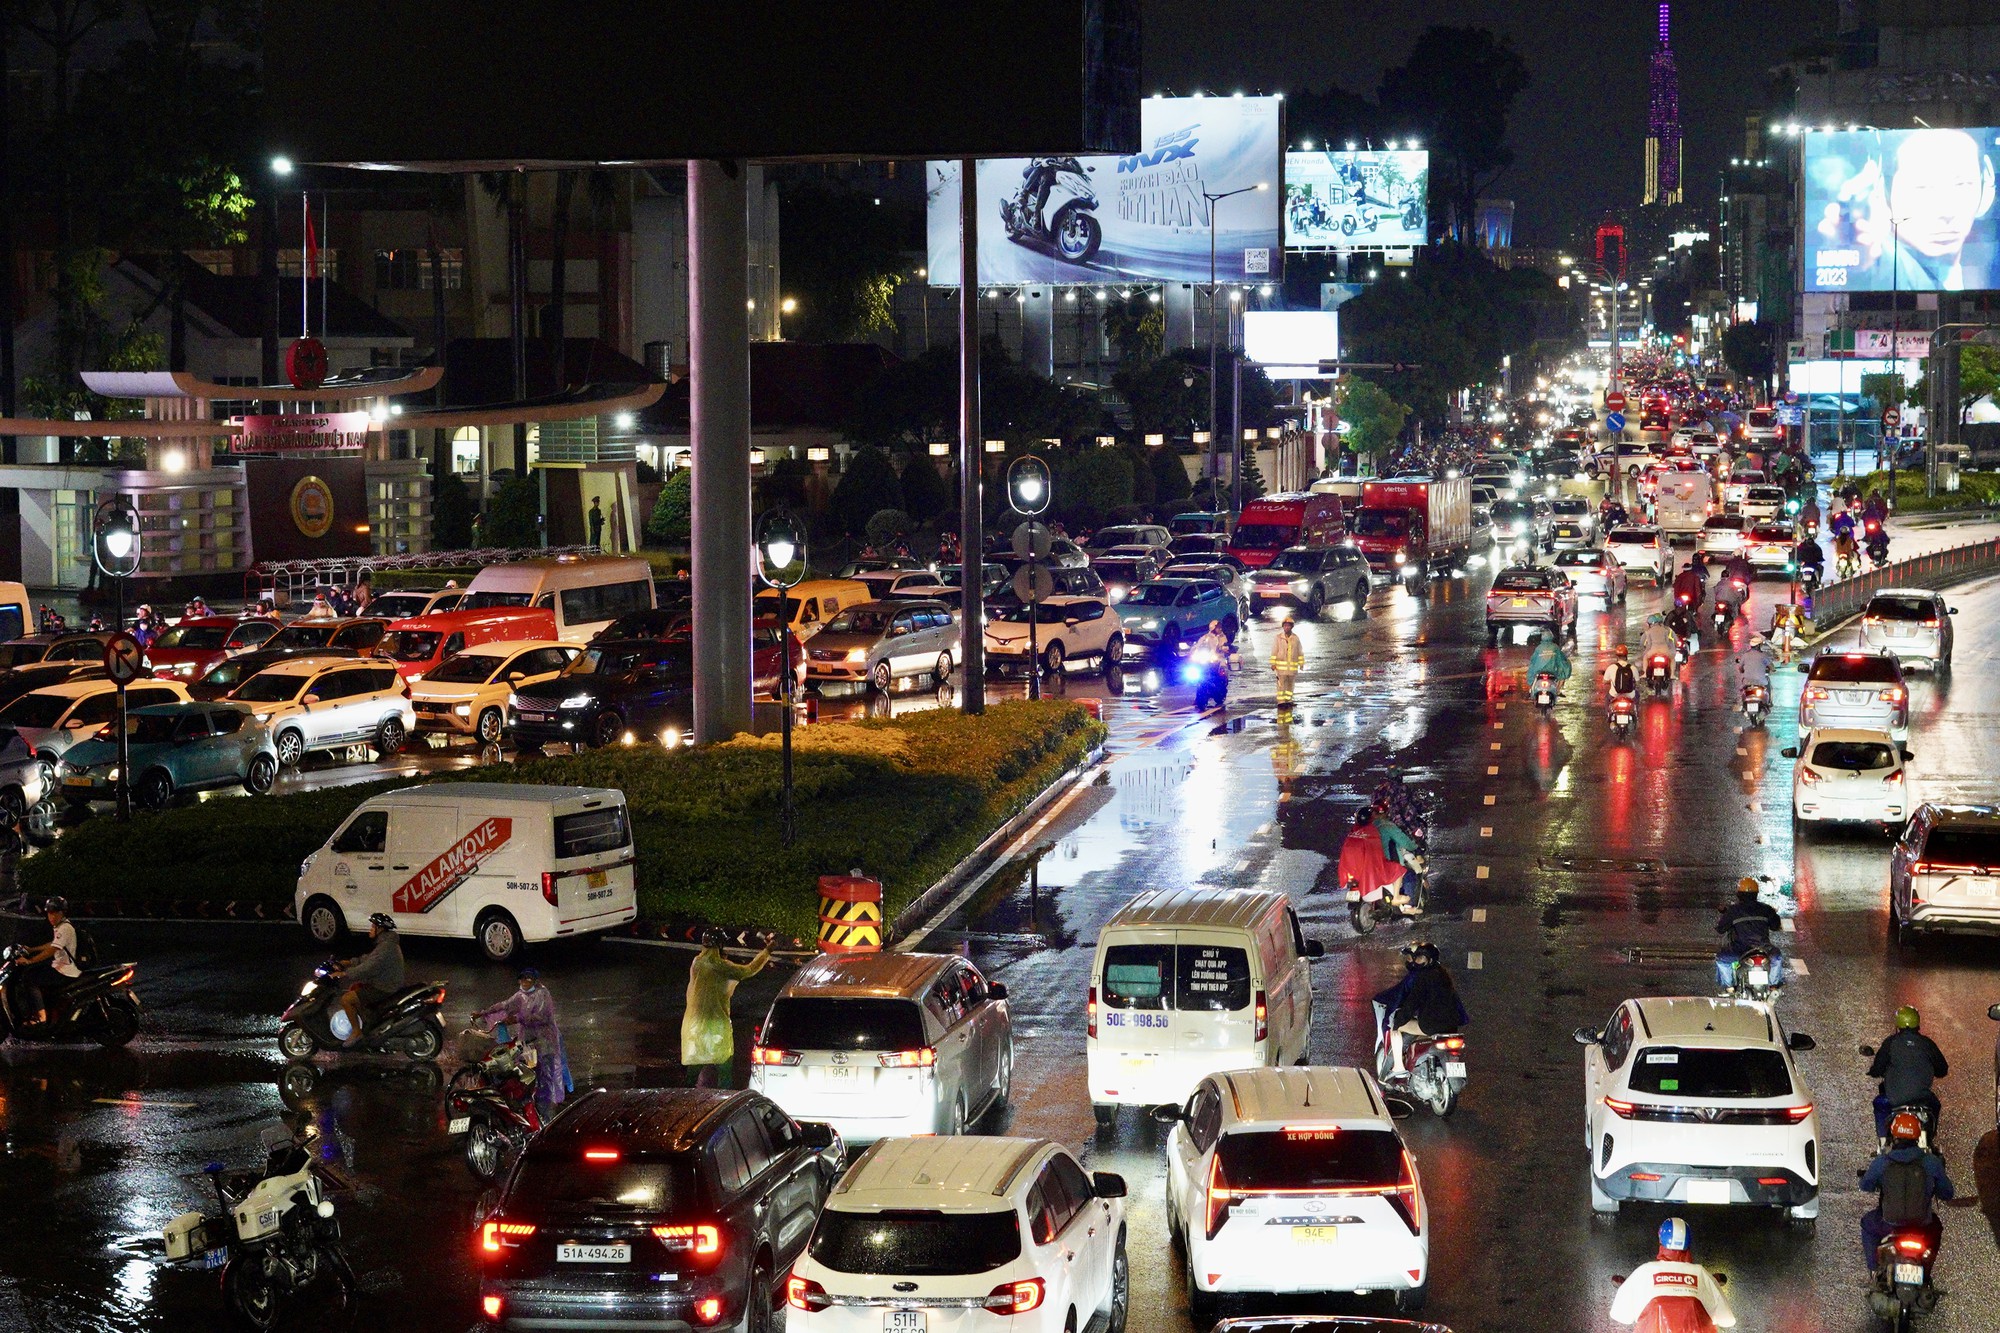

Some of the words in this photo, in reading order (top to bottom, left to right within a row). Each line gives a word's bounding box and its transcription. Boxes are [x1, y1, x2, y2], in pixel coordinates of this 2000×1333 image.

[1816, 268, 1847, 285] 2023
[409, 819, 498, 901] LALAMOVE
[1217, 960, 1227, 969] APP
[1219, 983, 1228, 992] APP
[832, 1067, 849, 1078] 95A
[1287, 1133, 1297, 1141] XE
[1299, 1132, 1313, 1142] HỢP
[1304, 1228, 1324, 1238] 94E
[563, 1248, 625, 1259] 51A-494.26
[1655, 1275, 1683, 1283] CIRCLE
[893, 1313, 917, 1327] 51H
